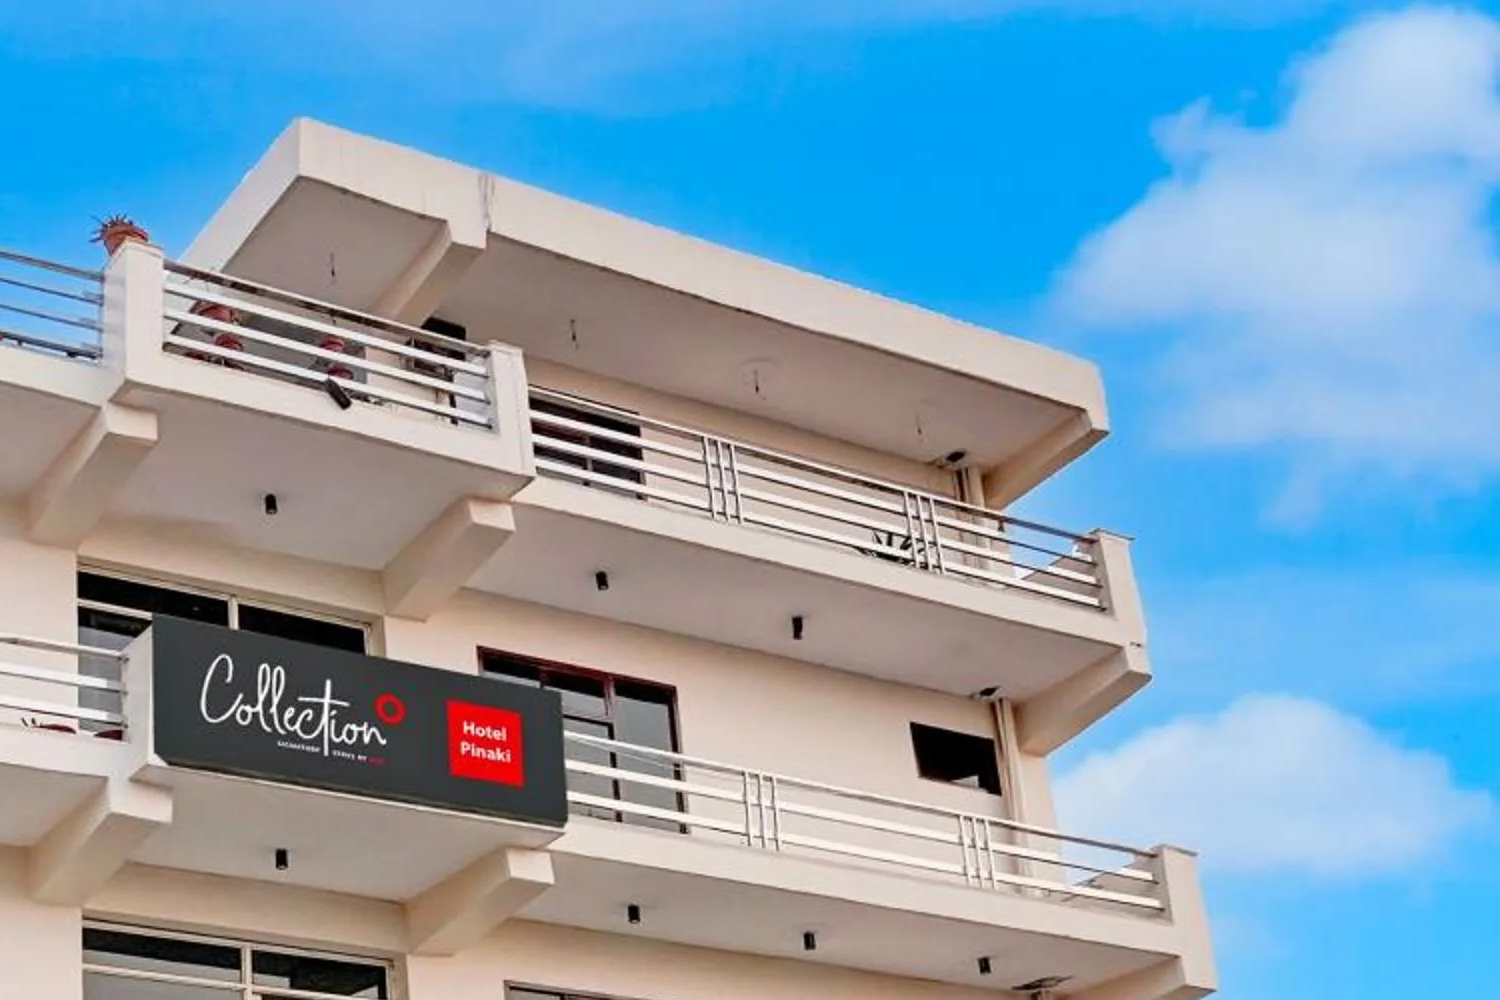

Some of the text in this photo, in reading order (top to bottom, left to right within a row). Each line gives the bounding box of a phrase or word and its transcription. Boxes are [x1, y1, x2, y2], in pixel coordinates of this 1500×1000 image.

[200, 653, 387, 757] Collection
[462, 720, 507, 742] Hotel
[460, 740, 512, 764] Pinaki
